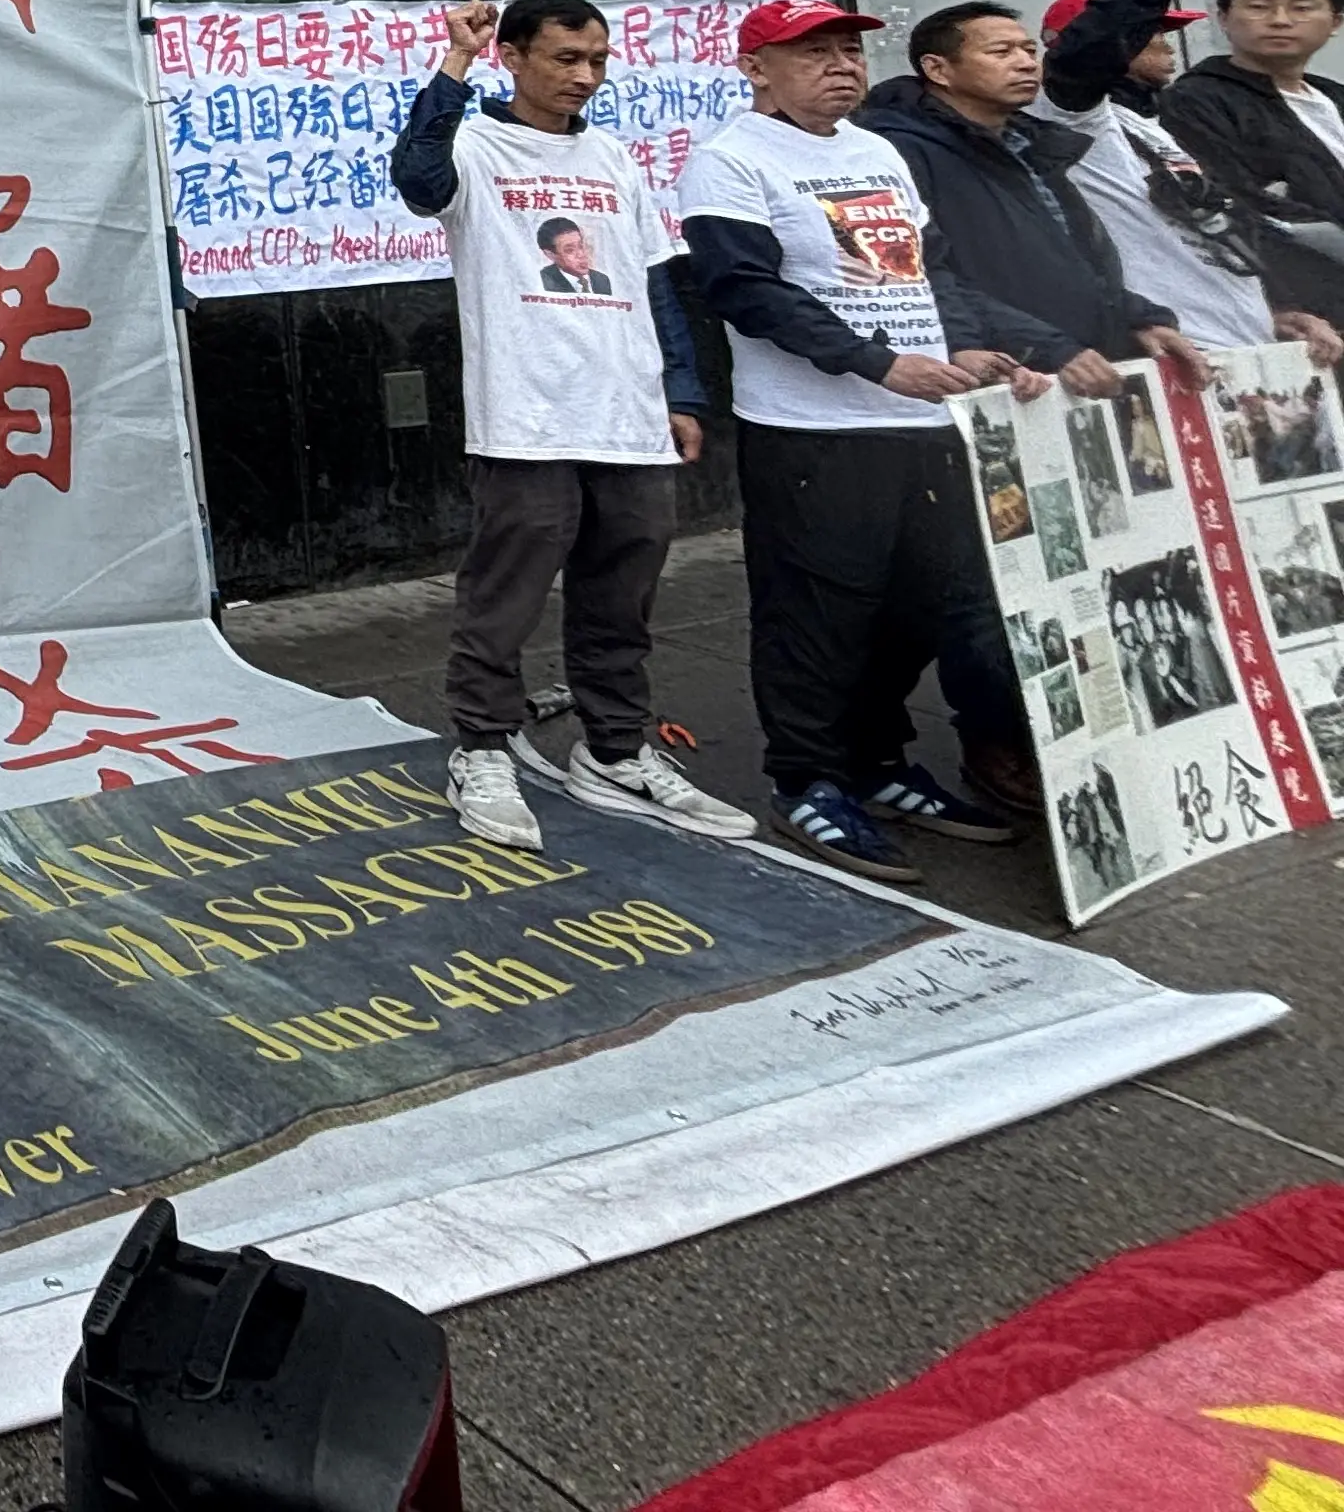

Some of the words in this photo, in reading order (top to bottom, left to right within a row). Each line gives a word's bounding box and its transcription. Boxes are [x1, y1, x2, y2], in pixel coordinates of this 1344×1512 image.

[843, 204, 907, 222] END
[854, 226, 912, 243] CCP
[261, 226, 299, 267] CCP
[302, 236, 321, 266] to
[330, 220, 381, 265] Kneel
[47, 837, 592, 987] MASSACRE
[216, 988, 440, 1063] June
[409, 948, 575, 1015] 4th
[523, 898, 716, 972] 1989
